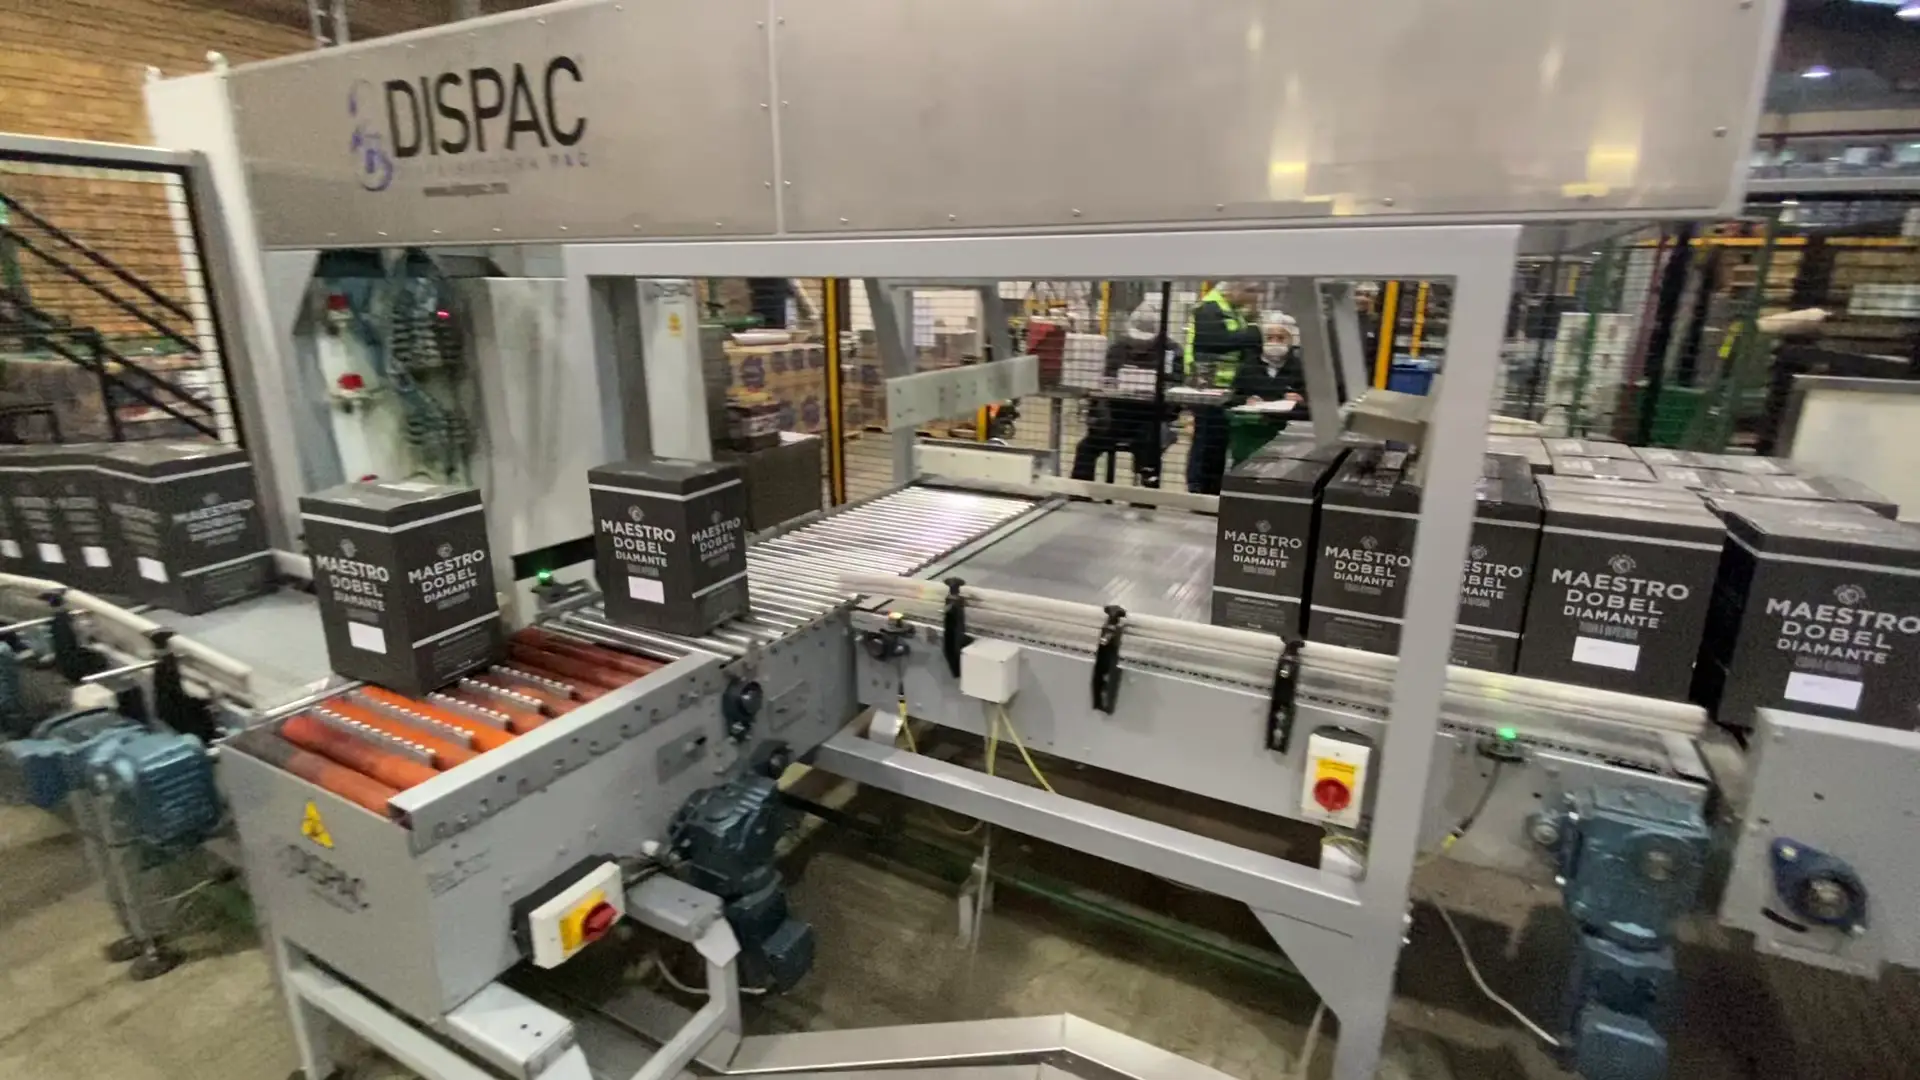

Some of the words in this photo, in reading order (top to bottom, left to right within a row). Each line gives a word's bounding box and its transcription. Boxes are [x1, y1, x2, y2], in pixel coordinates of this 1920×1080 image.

[384, 55, 588, 158] DISPAC
[601, 518, 676, 543] MAESTRO
[691, 517, 741, 544] MAESTRO
[700, 532, 736, 553] DOBEL
[1224, 529, 1303, 549] MAESTRO
[614, 536, 667, 556] DOBEL
[1233, 543, 1290, 559] DOBEL
[1324, 545, 1412, 567] MAESTRO
[315, 554, 390, 582] MAESTRO
[408, 549, 485, 584] MAESTRO
[615, 550, 668, 567] DIAMANTE
[1232, 554, 1288, 568] DIAMANTE
[1334, 559, 1397, 579] DOBEL
[1463, 560, 1523, 578] ESTRO
[328, 574, 384, 598] DOBEL
[421, 566, 477, 593] DOBEL
[424, 579, 478, 604] DIAMANTE
[1333, 571, 1394, 588] DIAMANTE
[1462, 574, 1507, 589] BEL
[1551, 567, 1690, 600] MAESTRO
[1461, 586, 1505, 600] MANTE
[1566, 589, 1665, 616] DOBEL
[1563, 604, 1661, 629] DIAMANTE
[1765, 597, 1920, 634] MAESTRO
[1781, 620, 1893, 650] DOBEL
[1776, 637, 1889, 665] DIAMANTE
